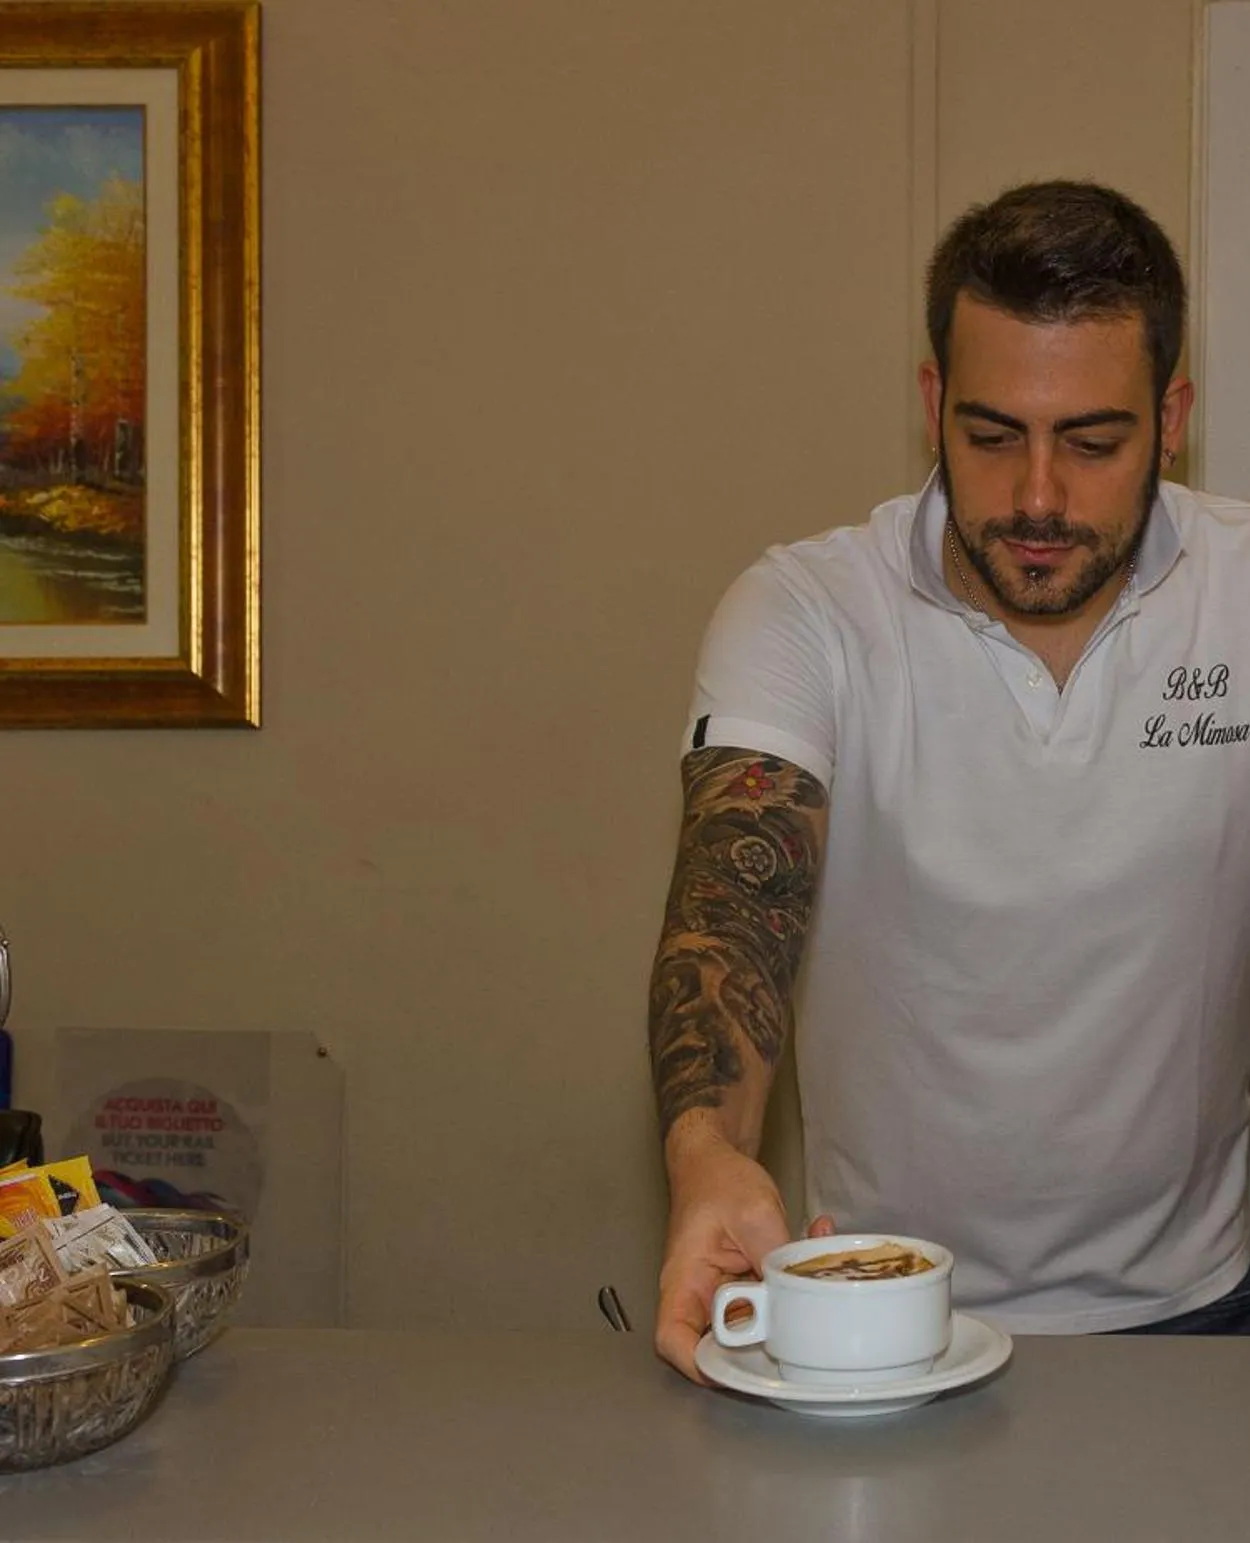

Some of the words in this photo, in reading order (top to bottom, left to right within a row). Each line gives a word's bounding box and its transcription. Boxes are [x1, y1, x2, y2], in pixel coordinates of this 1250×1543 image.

[1162, 663, 1230, 701] B&B
[1139, 713, 1174, 749] La
[1177, 711, 1250, 747] Mimosa
